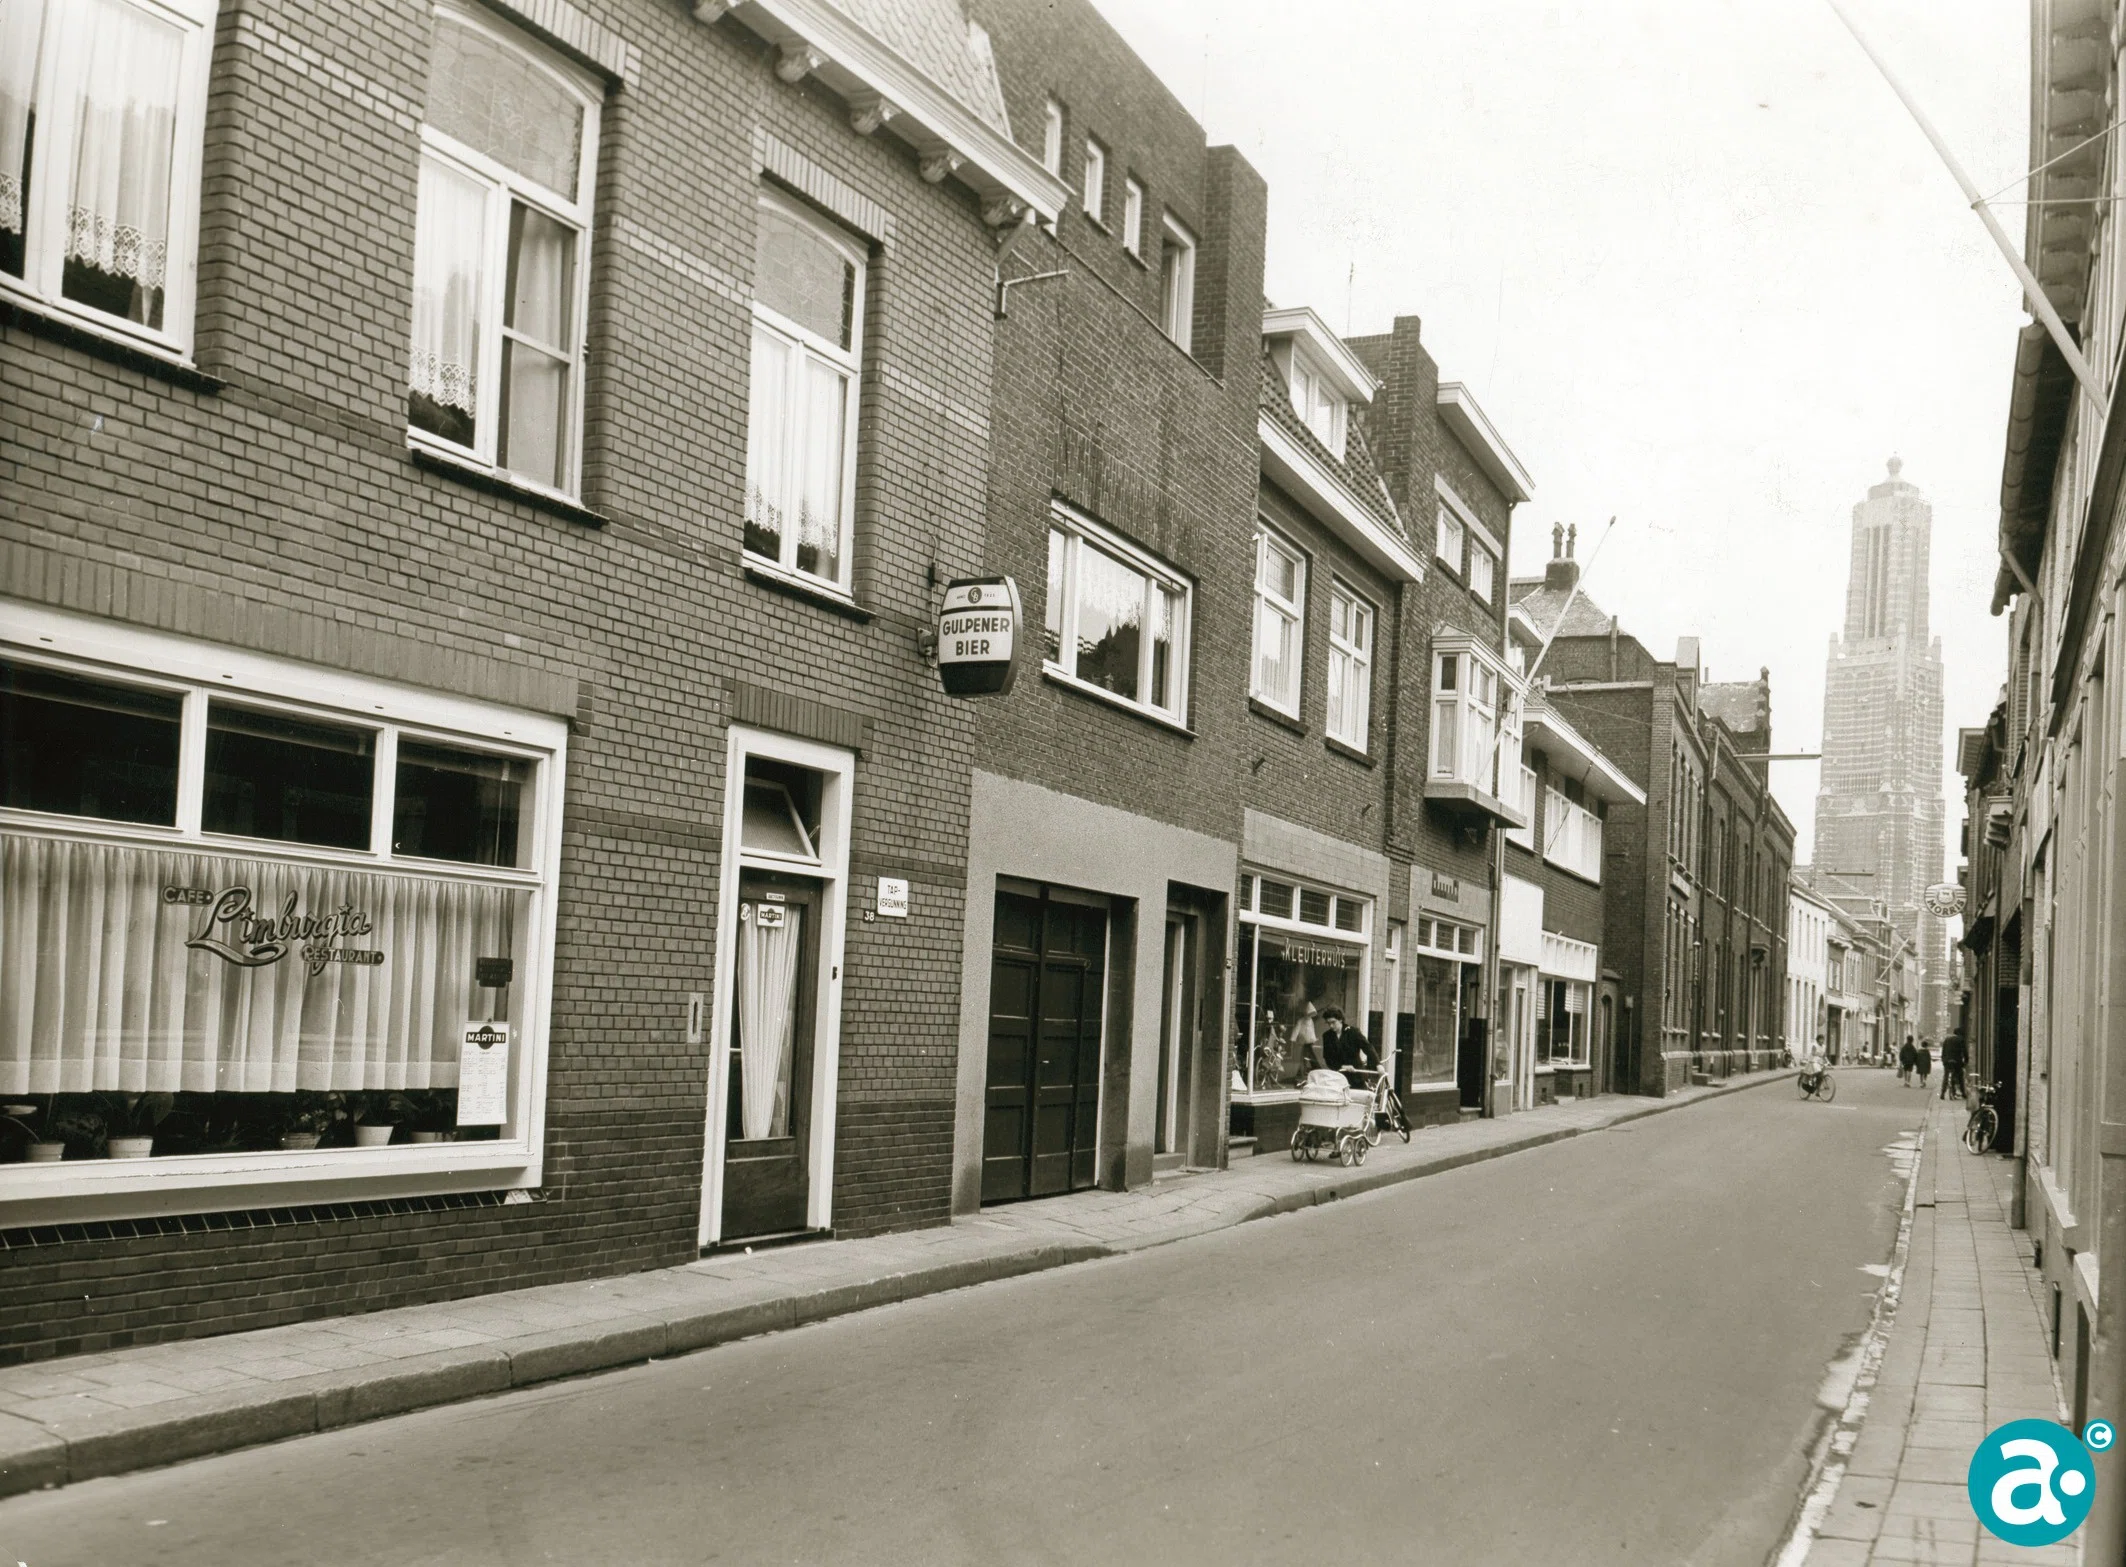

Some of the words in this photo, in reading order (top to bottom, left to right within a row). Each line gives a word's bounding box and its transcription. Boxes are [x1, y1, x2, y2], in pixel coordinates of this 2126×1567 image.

[942, 617, 1010, 635] GULPENER
[955, 639, 990, 656] BIER
[761, 911, 782, 920] MARTINI
[864, 910, 875, 921] 38
[1927, 899, 1965, 916] MORRIS
[184, 885, 373, 976] Limburgia
[303, 944, 377, 964] RESTAURANT
[1285, 943, 1346, 969] KLEUTERHUIS
[467, 1033, 505, 1042] MARTINI
